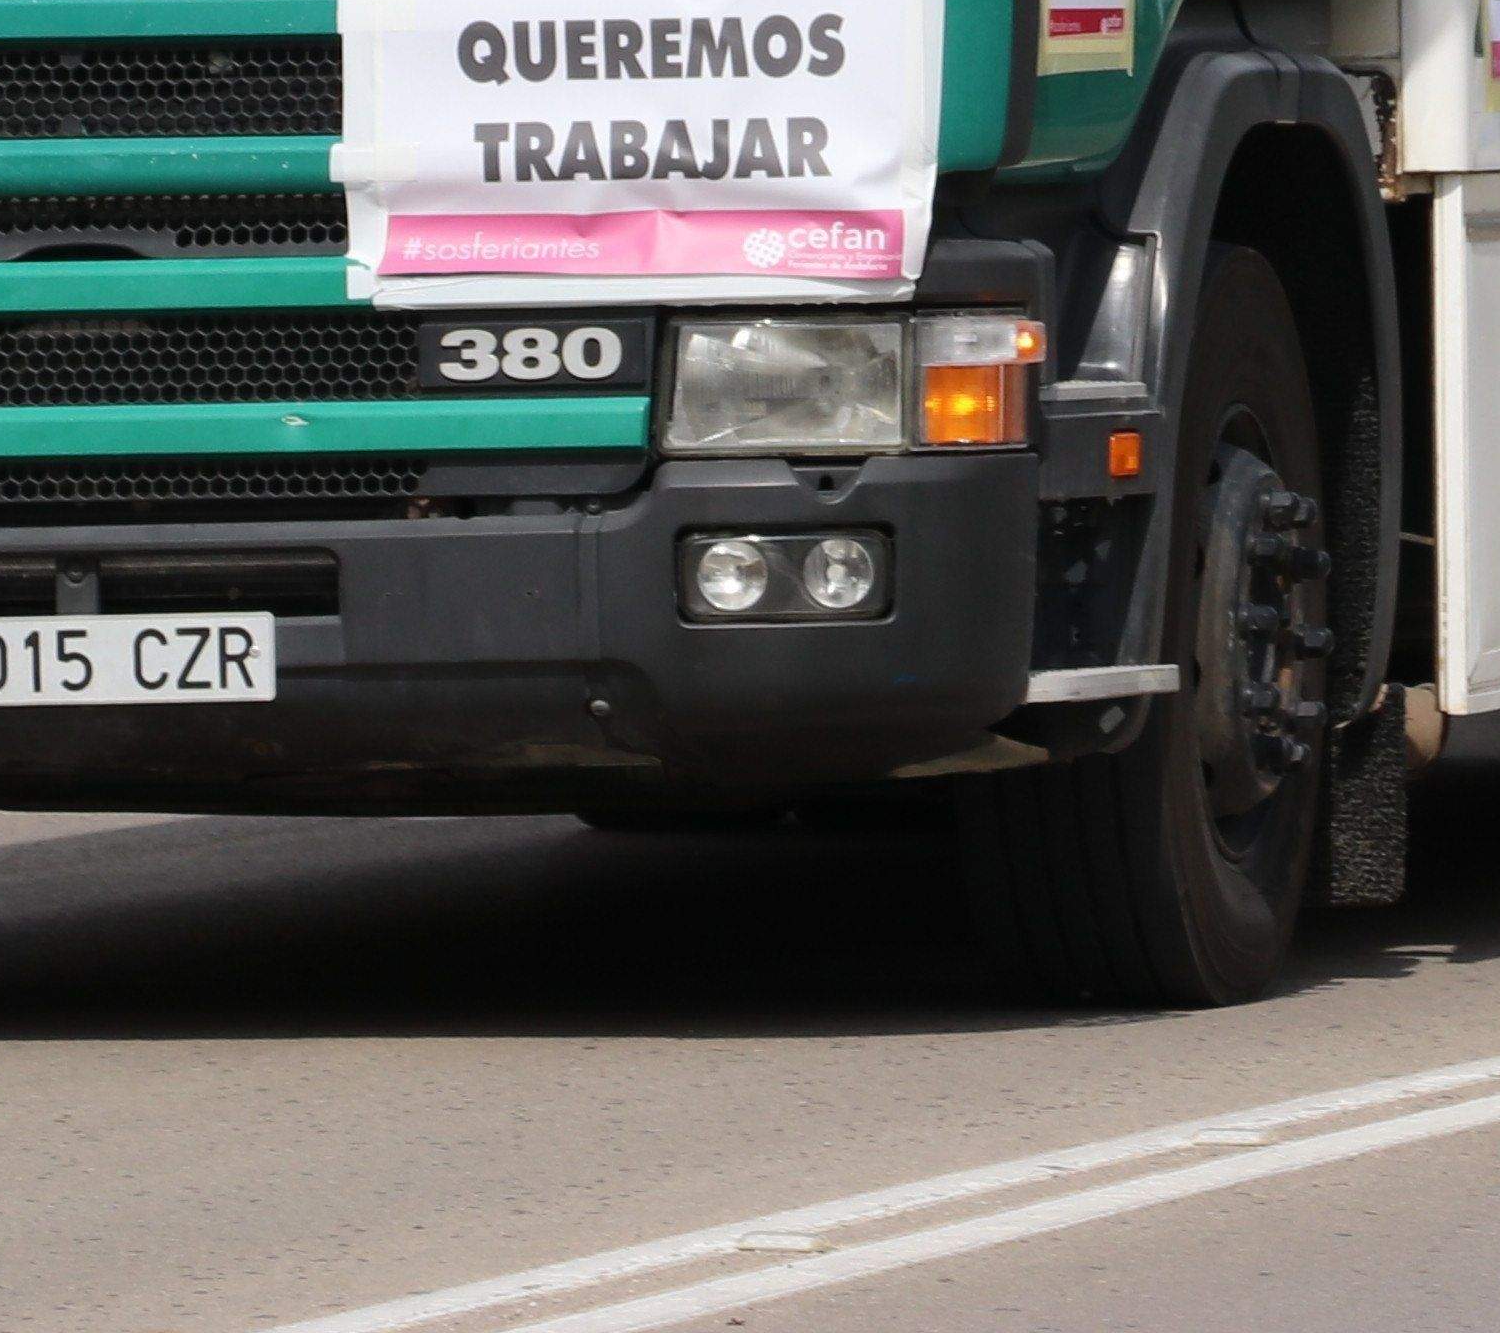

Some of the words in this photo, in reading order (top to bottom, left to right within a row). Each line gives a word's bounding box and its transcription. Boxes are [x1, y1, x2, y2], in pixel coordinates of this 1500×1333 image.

[457, 14, 846, 85] QUEREMOS
[473, 117, 831, 183] TRABAJAR
[402, 231, 600, 262] #sosferiantes
[788, 220, 886, 250] cefan
[438, 327, 623, 381] 380
[133, 627, 256, 691] CZR
